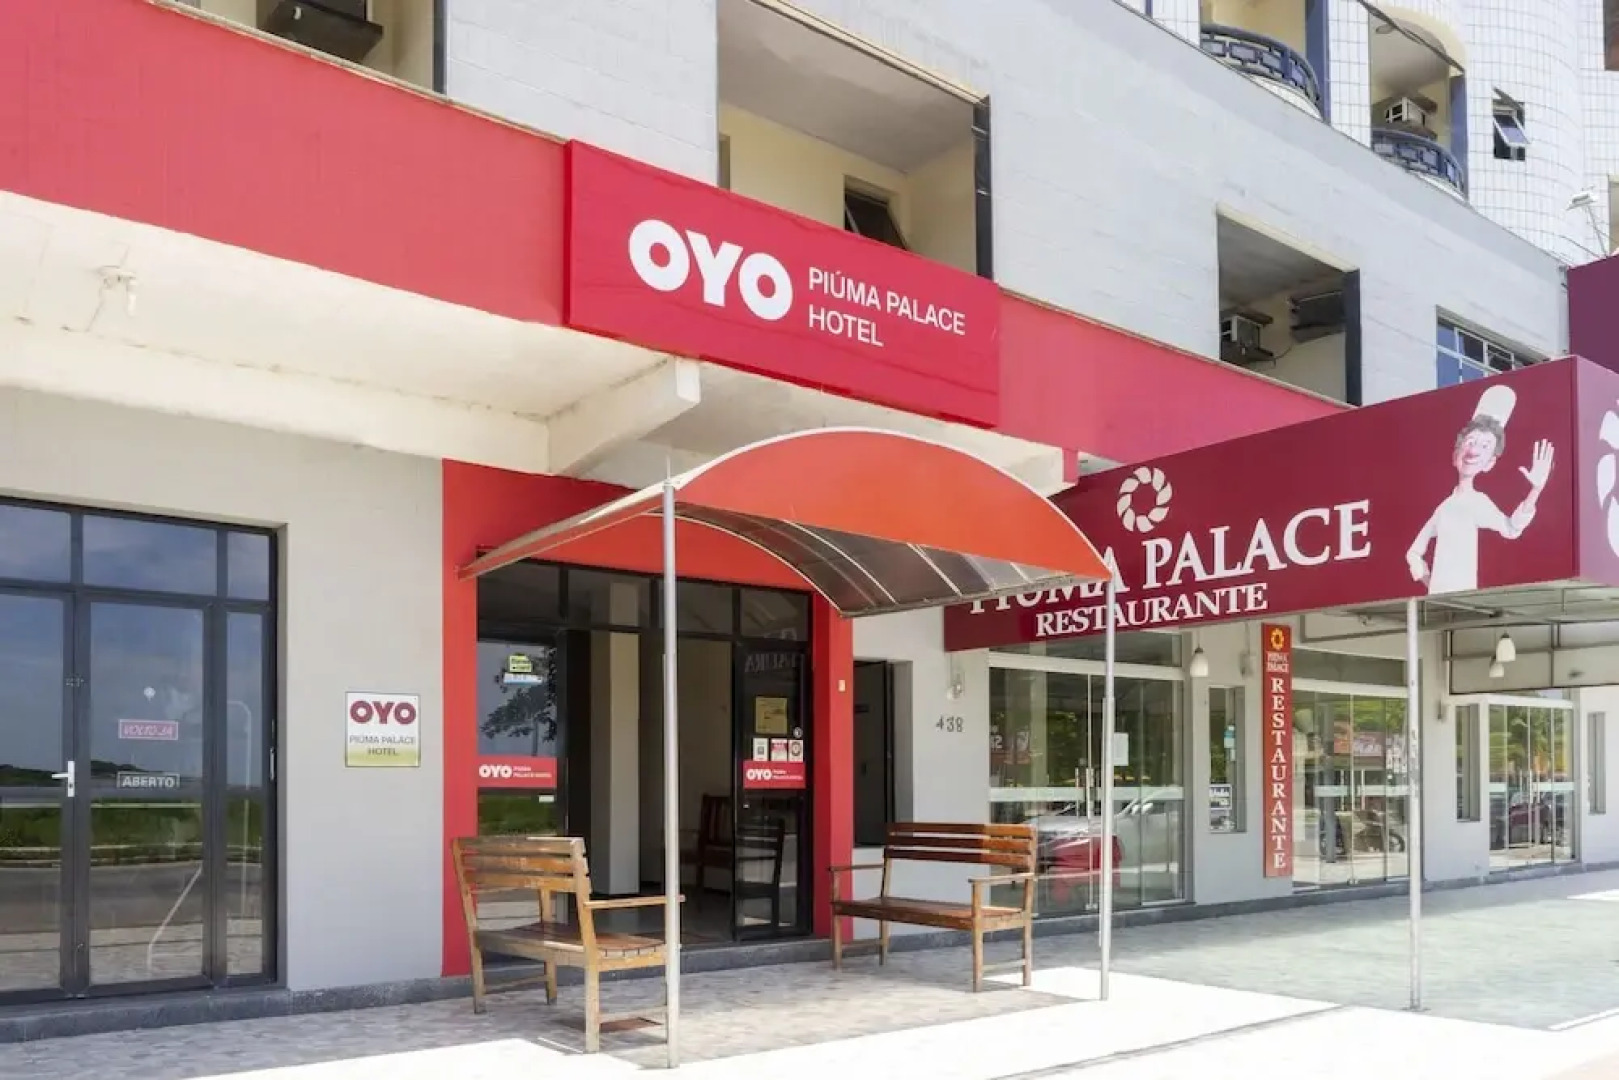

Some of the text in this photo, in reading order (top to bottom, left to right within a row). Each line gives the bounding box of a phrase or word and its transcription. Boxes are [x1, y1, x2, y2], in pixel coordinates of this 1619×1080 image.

[628, 219, 793, 320] OYO
[808, 266, 966, 335] PIÚMA PALACE
[808, 304, 884, 347] HOTEL
[1141, 499, 1372, 590] PALACE
[1035, 582, 1268, 637] RESTAURANTE
[349, 700, 417, 725] OYO
[935, 716, 964, 733] 438
[122, 775, 174, 788] ABERTO
[478, 764, 513, 778] OYO
[746, 768, 772, 781] OYO
[1271, 677, 1286, 869] RESTAURANTE
